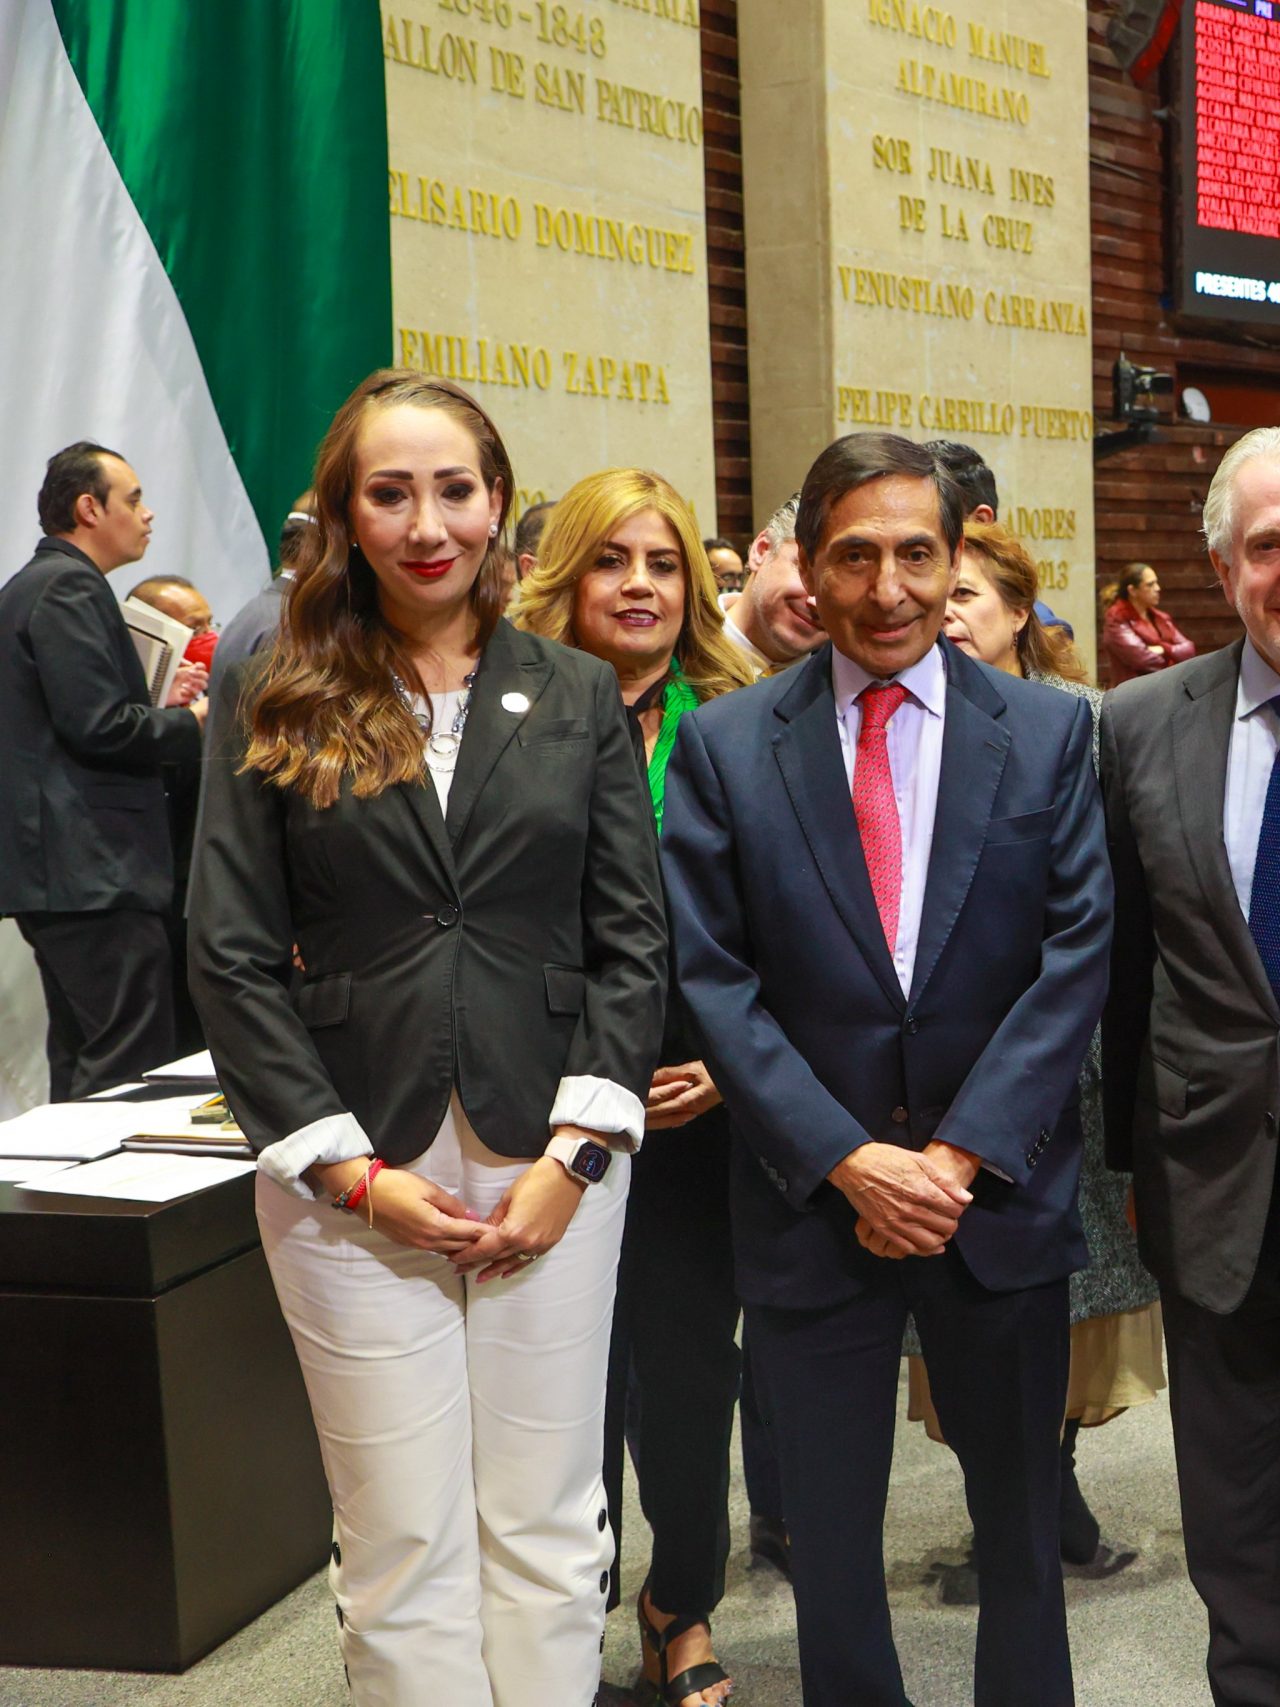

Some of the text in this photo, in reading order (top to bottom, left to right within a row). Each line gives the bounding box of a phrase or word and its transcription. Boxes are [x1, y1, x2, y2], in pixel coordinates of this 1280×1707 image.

[438, 0, 606, 59] 46-1848
[868, 0, 1050, 79] IGNACIO MANUEL
[1196, 18, 1230, 40] ACEVES
[1232, 27, 1265, 49] GARCIA
[1196, 34, 1232, 56] ACOSTA
[896, 58, 1030, 126] ALTAMIRANO
[1196, 50, 1237, 72] AGUILAR
[1238, 59, 1280, 82] CASTILLO
[1197, 66, 1237, 88] AGUILAR
[489, 46, 525, 98] DE
[534, 61, 585, 115] SAN
[596, 78, 702, 146] PATRICIO
[1197, 98, 1231, 120] ALCALA
[1197, 115, 1250, 139] ALCANTARA
[872, 134, 1055, 208] SOR JUANA INES
[898, 194, 1033, 255] DE LA CRUZ
[1198, 195, 1228, 213] AYALA
[534, 203, 696, 274] DOMINGUEZ
[838, 265, 1088, 337] VENUSTIANO CARRANZA
[1196, 271, 1267, 302] PRESENTES
[400, 328, 670, 405] EMILIANO ZAPATA
[837, 386, 1093, 441] FELIPE CARRILLO PUERTO
